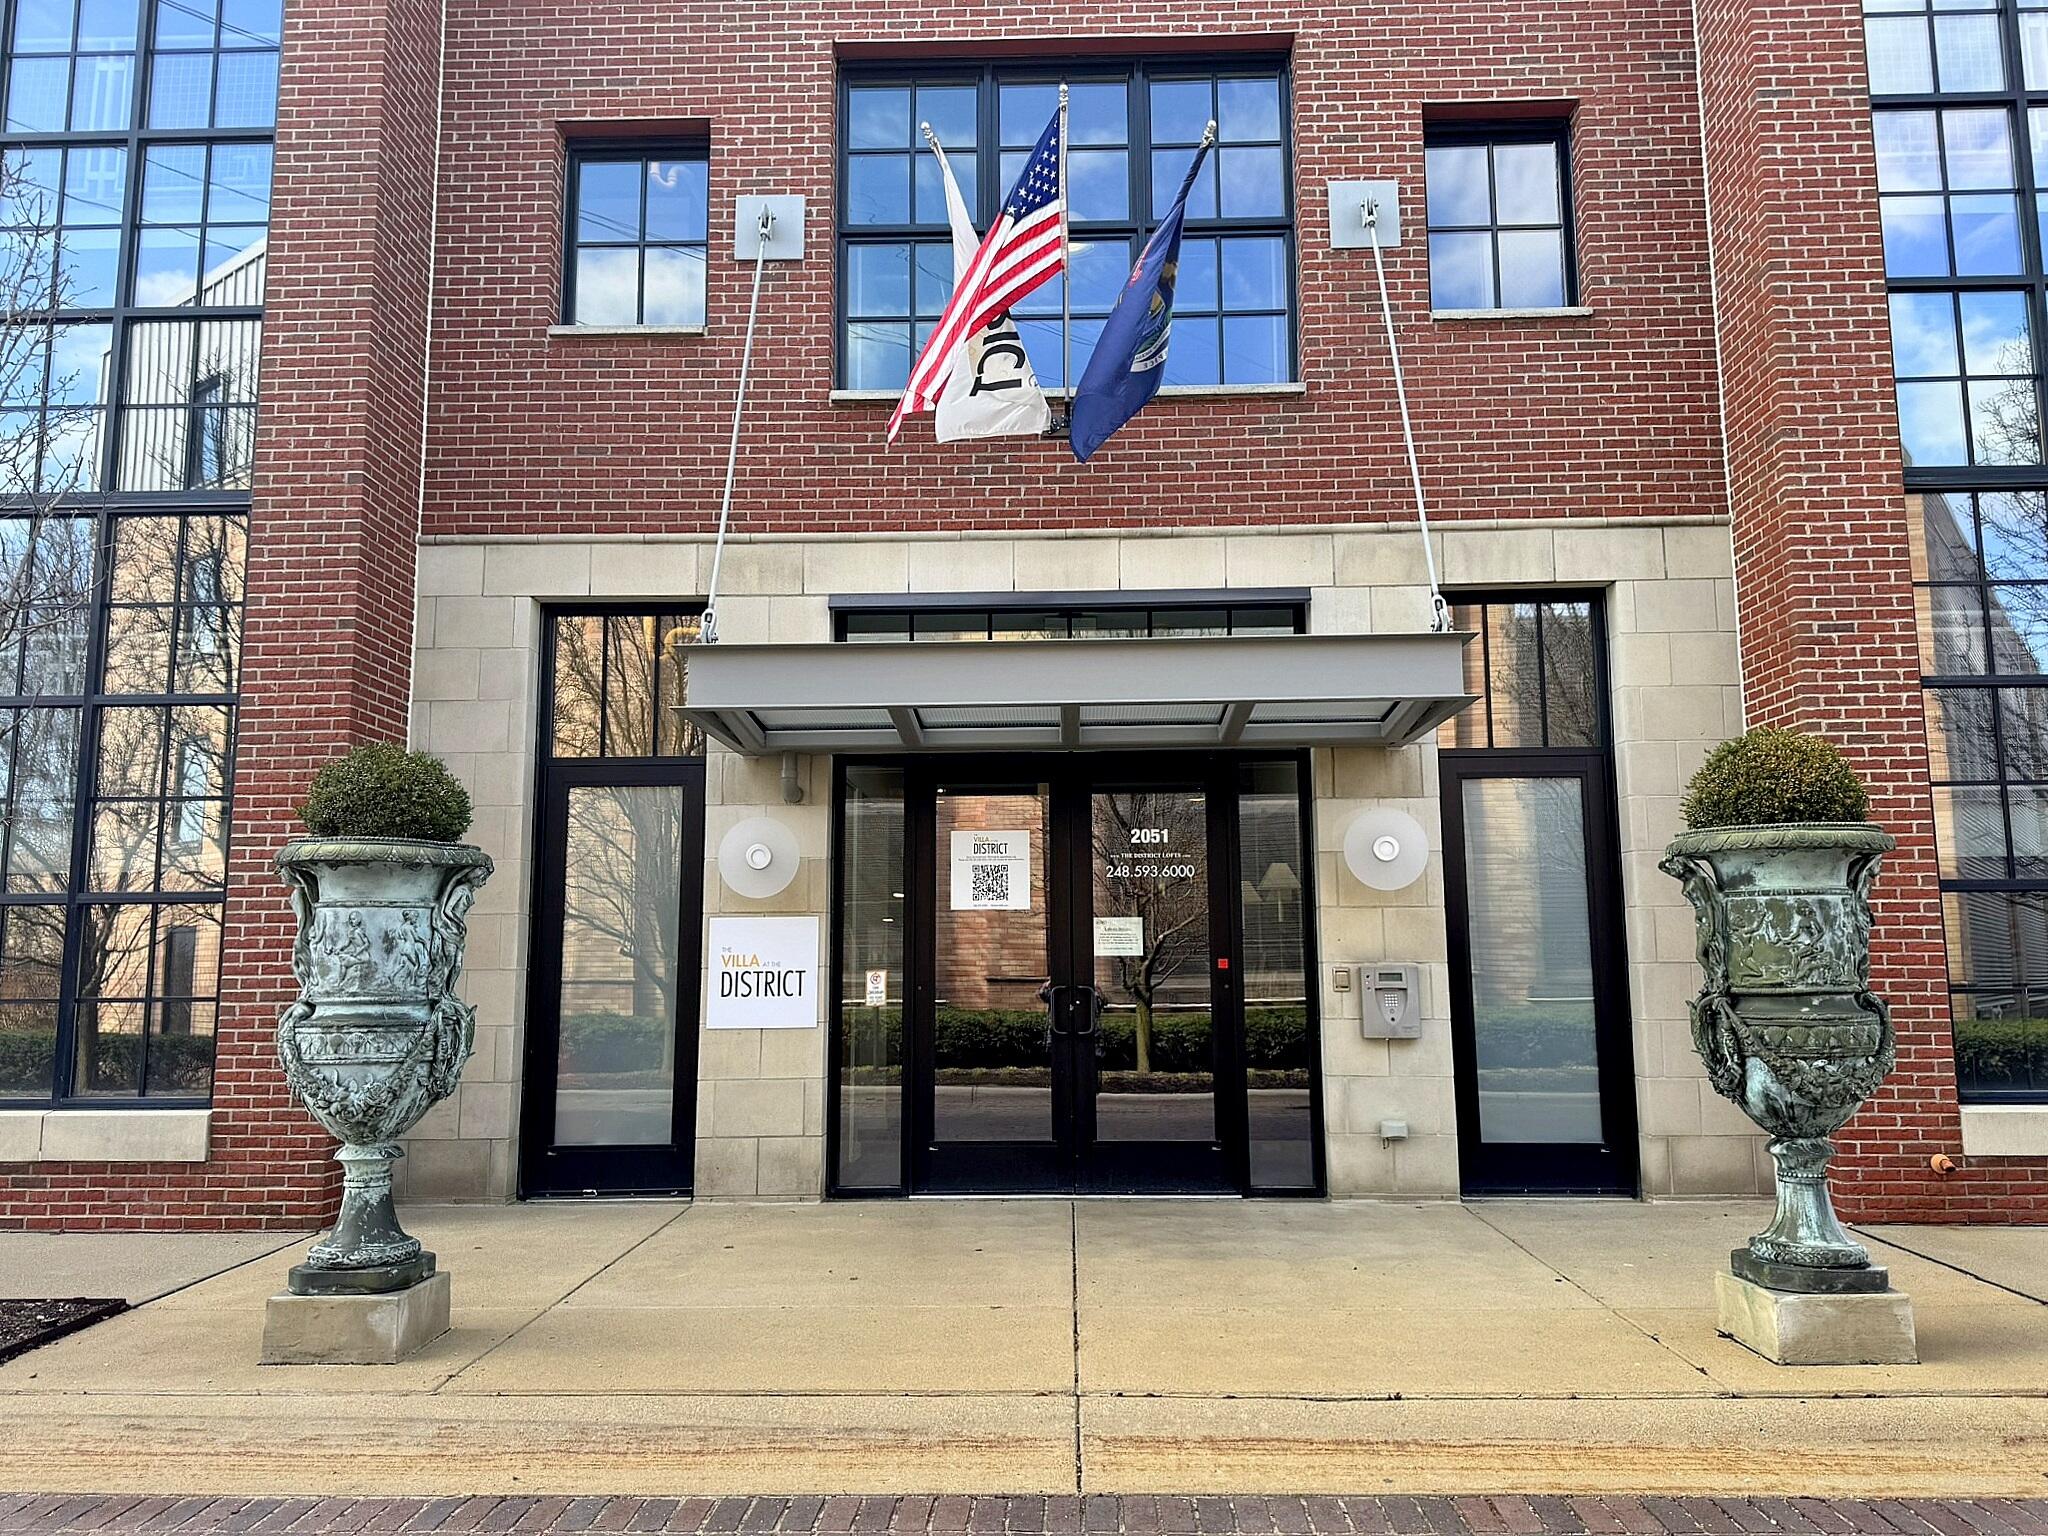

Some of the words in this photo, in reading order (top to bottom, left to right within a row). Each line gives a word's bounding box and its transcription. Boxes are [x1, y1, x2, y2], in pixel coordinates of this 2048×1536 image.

[1130, 828, 1169, 844] 2051
[973, 843, 1008, 855] DISTRICT
[1105, 865, 1195, 878] 248.593.6000
[721, 954, 760, 967] VILLA
[721, 970, 806, 998] DISTRICT
